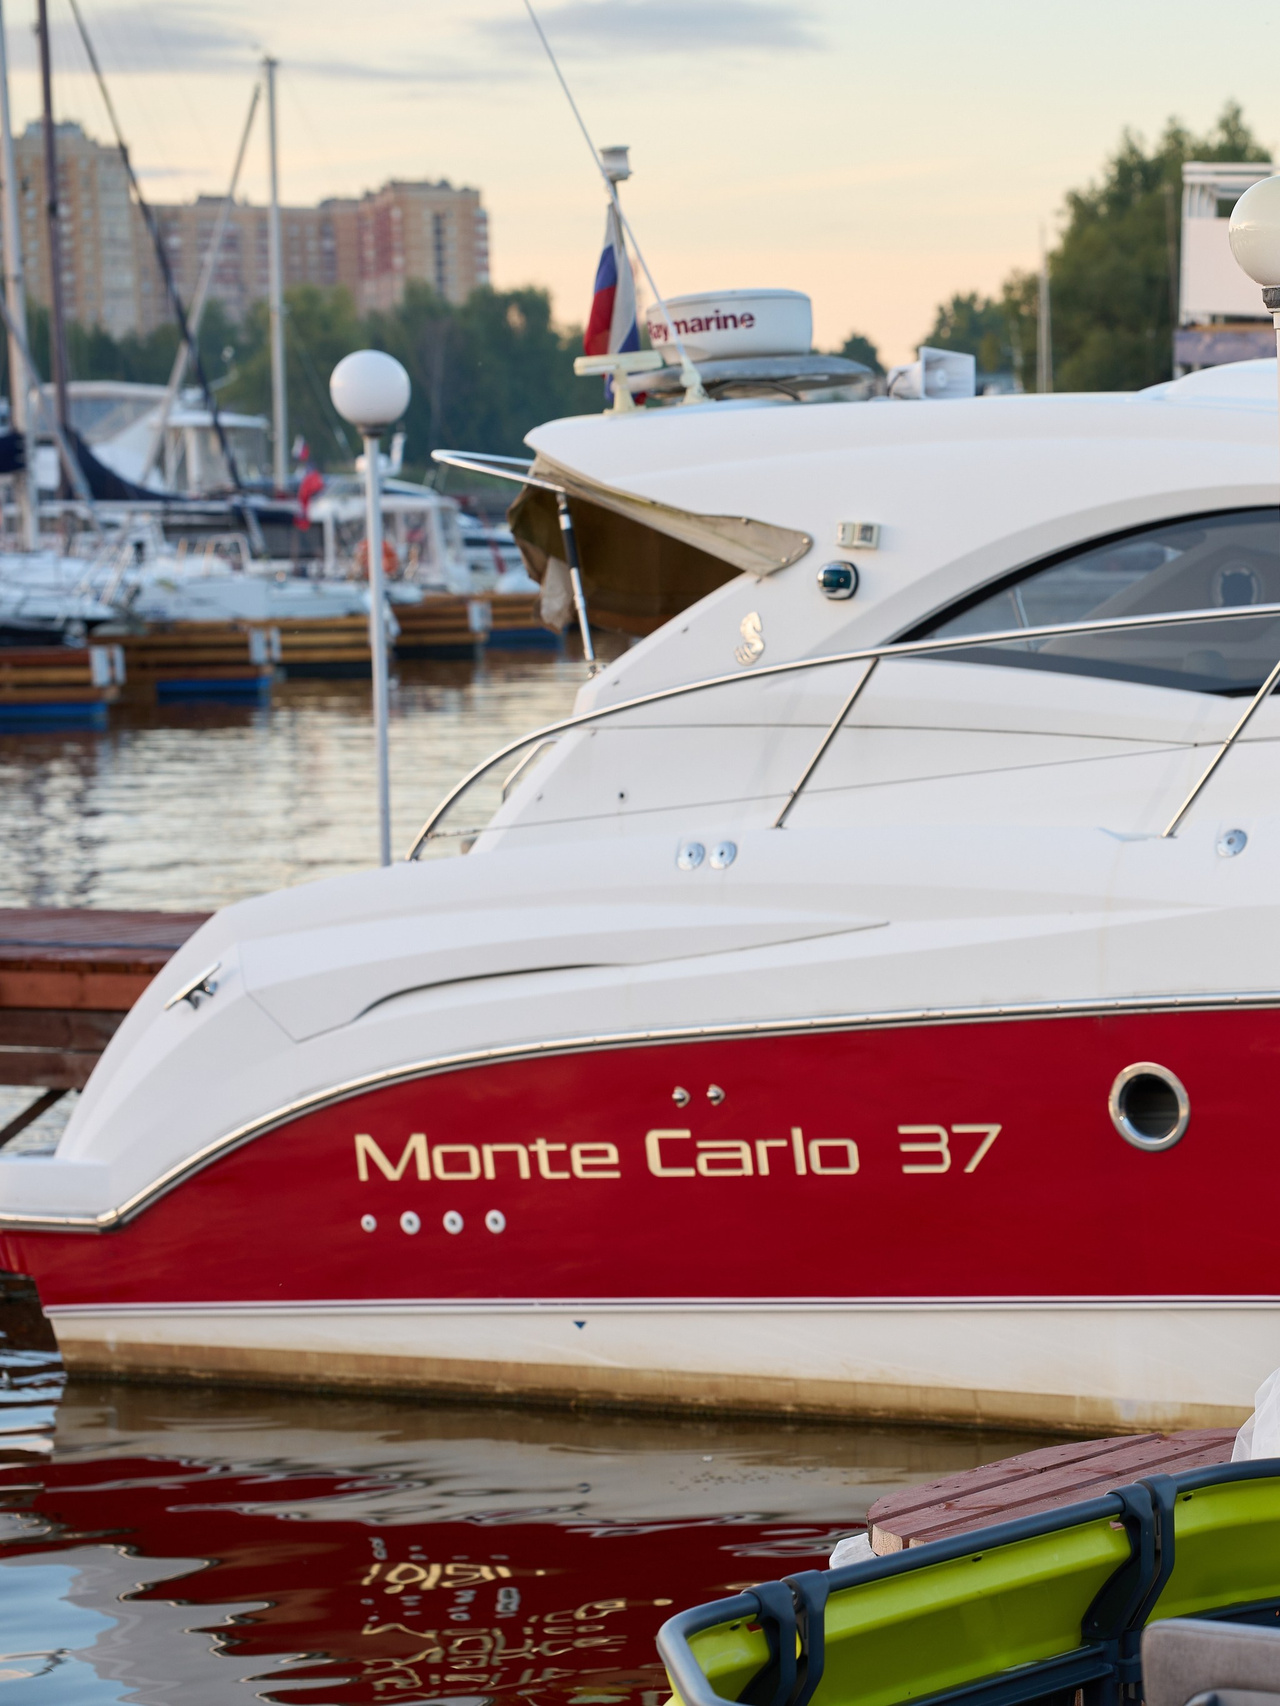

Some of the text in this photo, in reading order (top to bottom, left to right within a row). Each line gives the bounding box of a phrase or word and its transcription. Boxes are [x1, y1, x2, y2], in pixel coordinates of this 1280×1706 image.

[354, 1123, 1003, 1182] Monte Carlo 37
